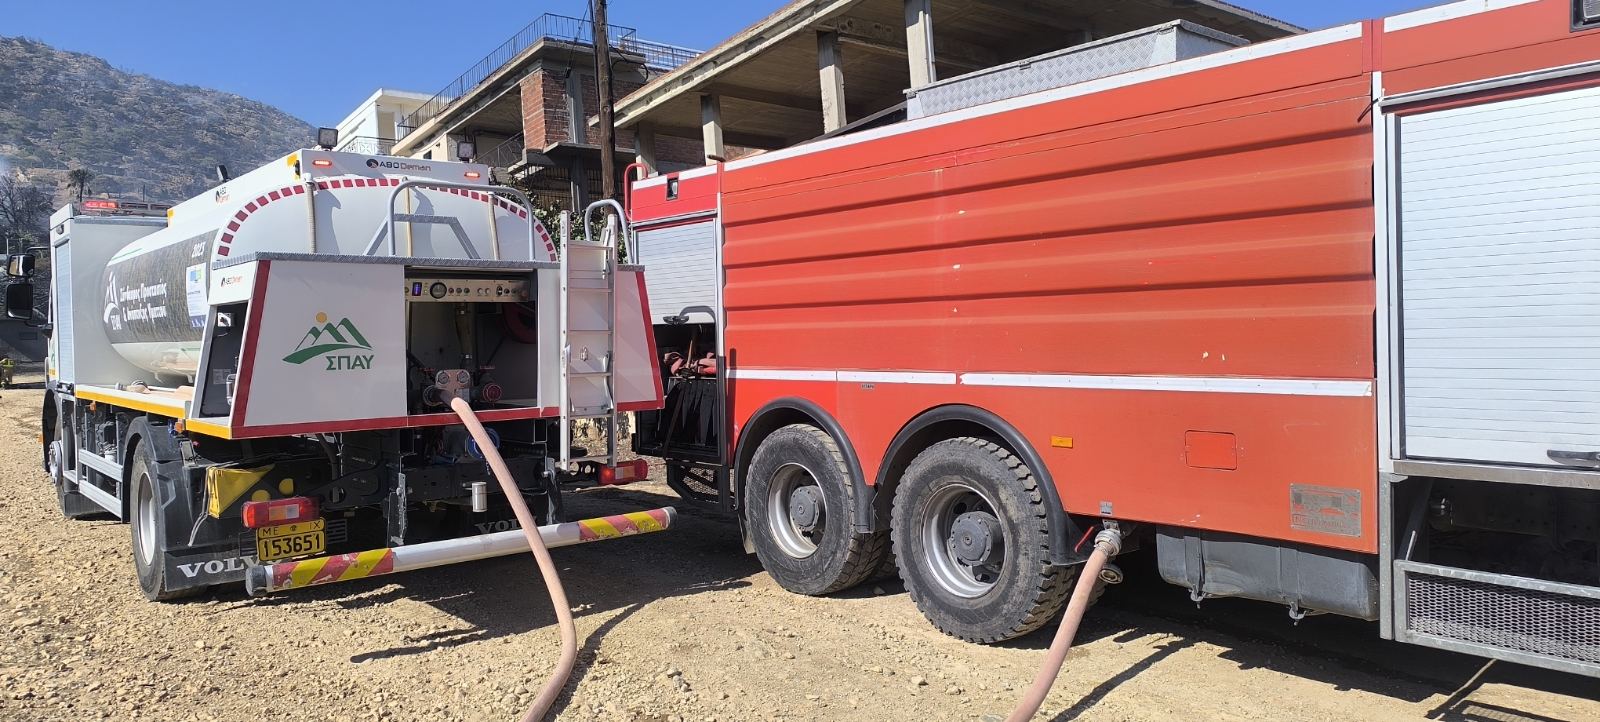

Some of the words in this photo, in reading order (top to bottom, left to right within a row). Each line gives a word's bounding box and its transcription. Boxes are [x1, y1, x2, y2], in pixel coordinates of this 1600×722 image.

[325, 354, 374, 370] ΣΠΑΥ
[264, 533, 320, 557] 153651
[177, 555, 282, 578] VOLV
